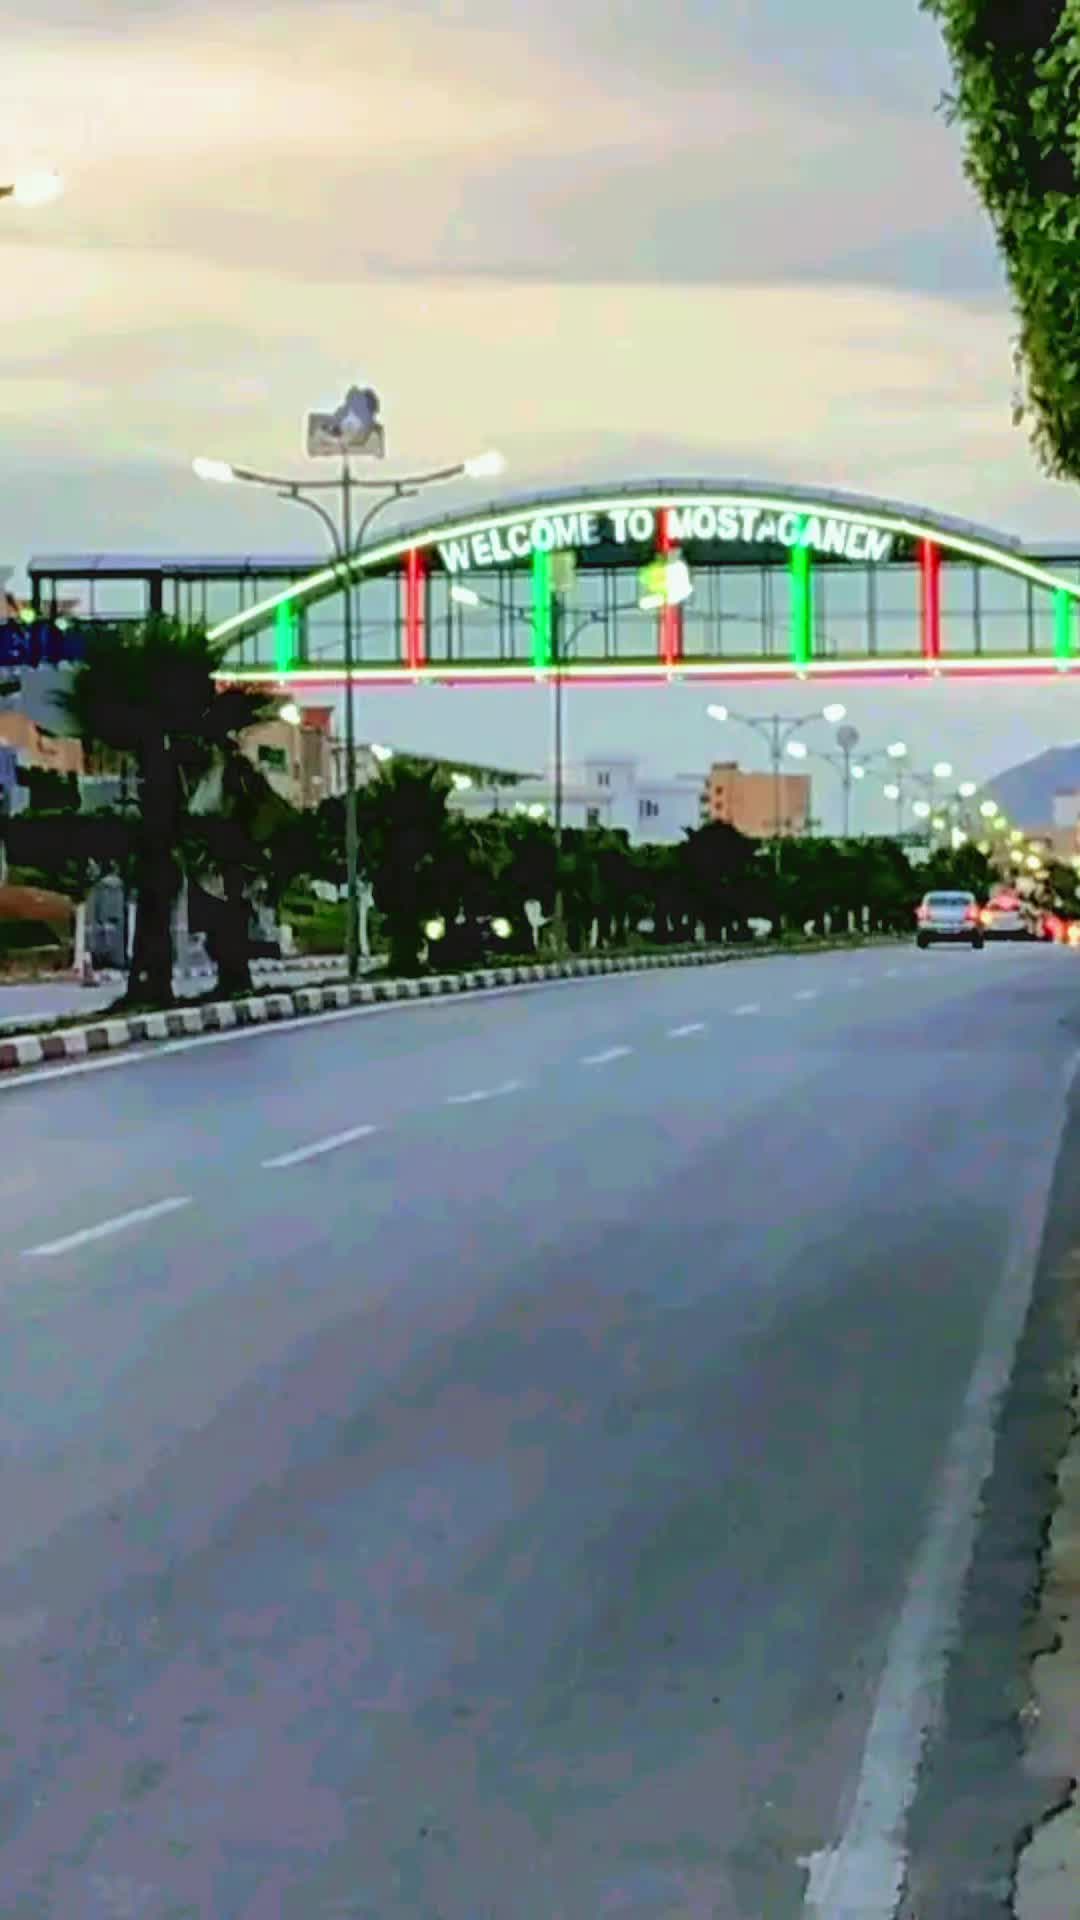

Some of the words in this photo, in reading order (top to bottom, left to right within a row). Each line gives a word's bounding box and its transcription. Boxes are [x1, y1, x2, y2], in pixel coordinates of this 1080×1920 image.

[437, 512, 600, 574] WELCOME
[608, 509, 654, 543] TO
[667, 506, 892, 561] MOSTAGANEM
